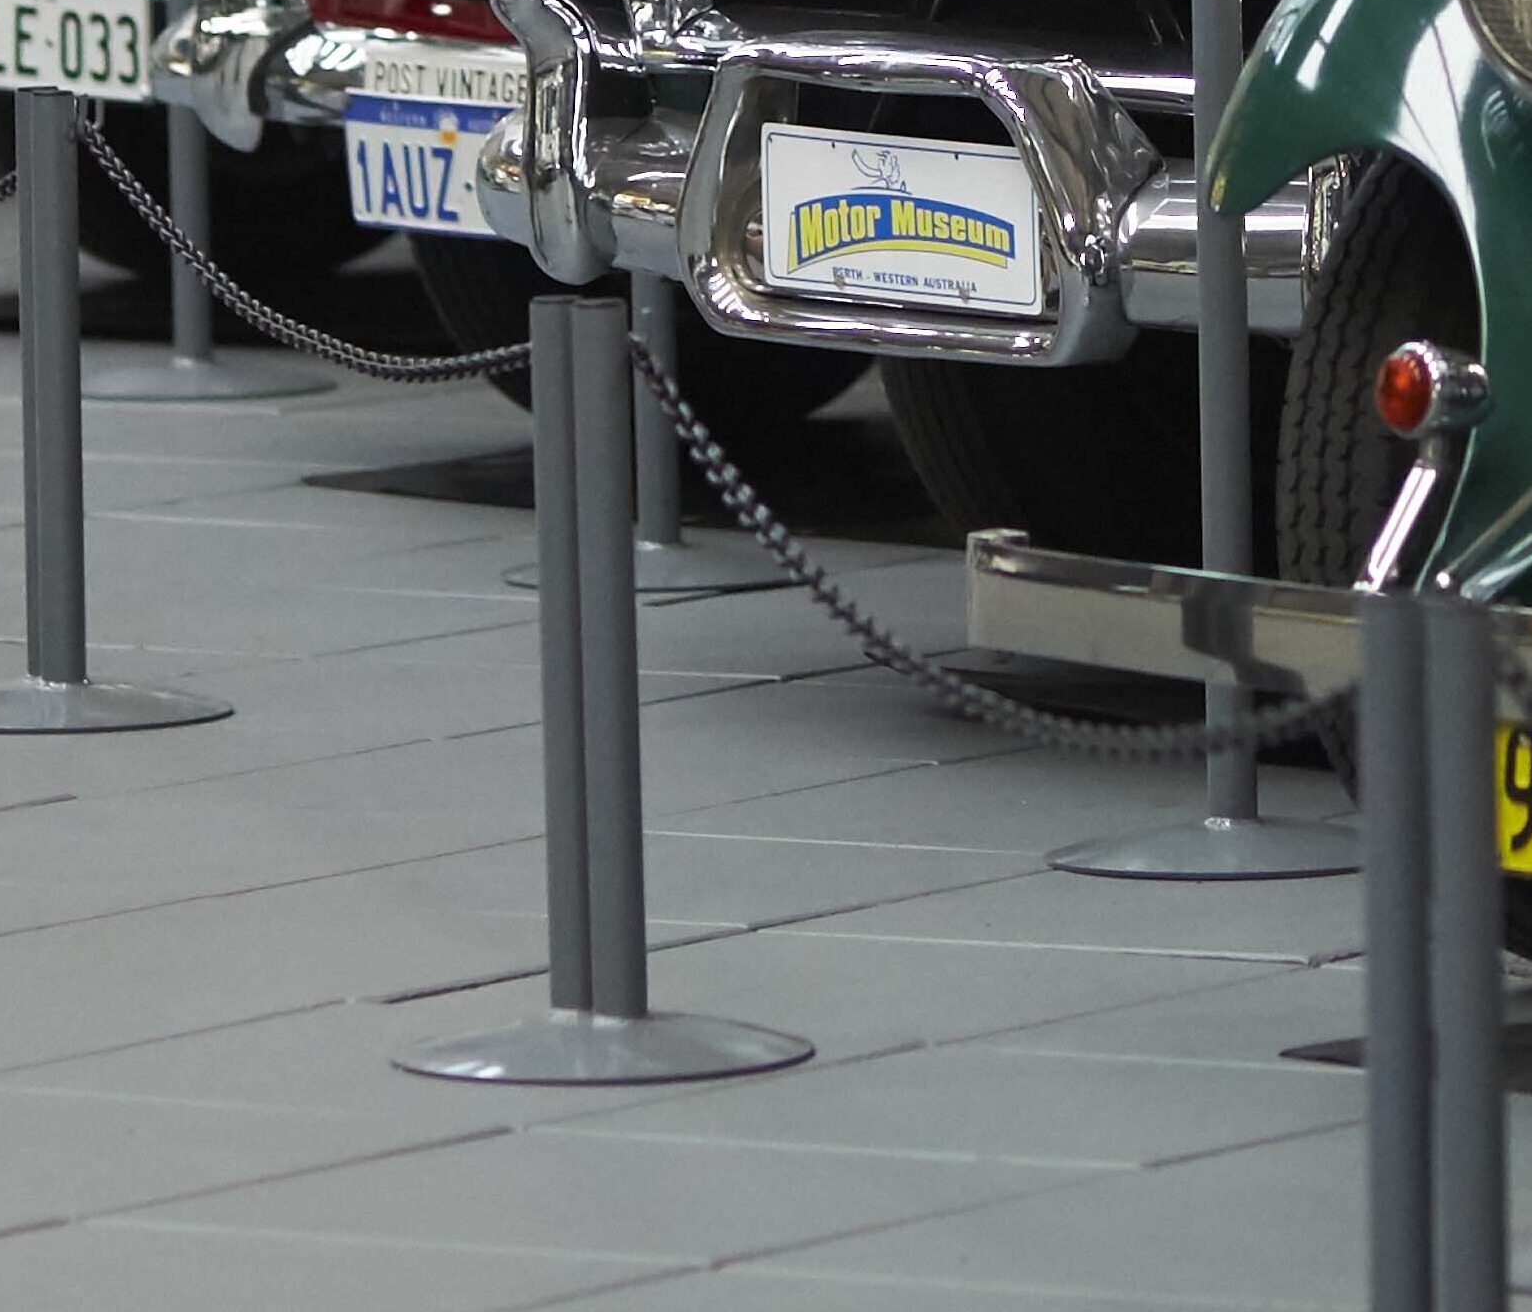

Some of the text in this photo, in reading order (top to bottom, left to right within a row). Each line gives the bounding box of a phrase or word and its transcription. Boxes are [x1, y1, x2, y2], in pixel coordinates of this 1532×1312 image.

[374, 60, 529, 105] POST VINTAGE
[799, 198, 1011, 259] Motor Museum
[833, 266, 864, 282] PERTH
[873, 271, 919, 287] WESTERN
